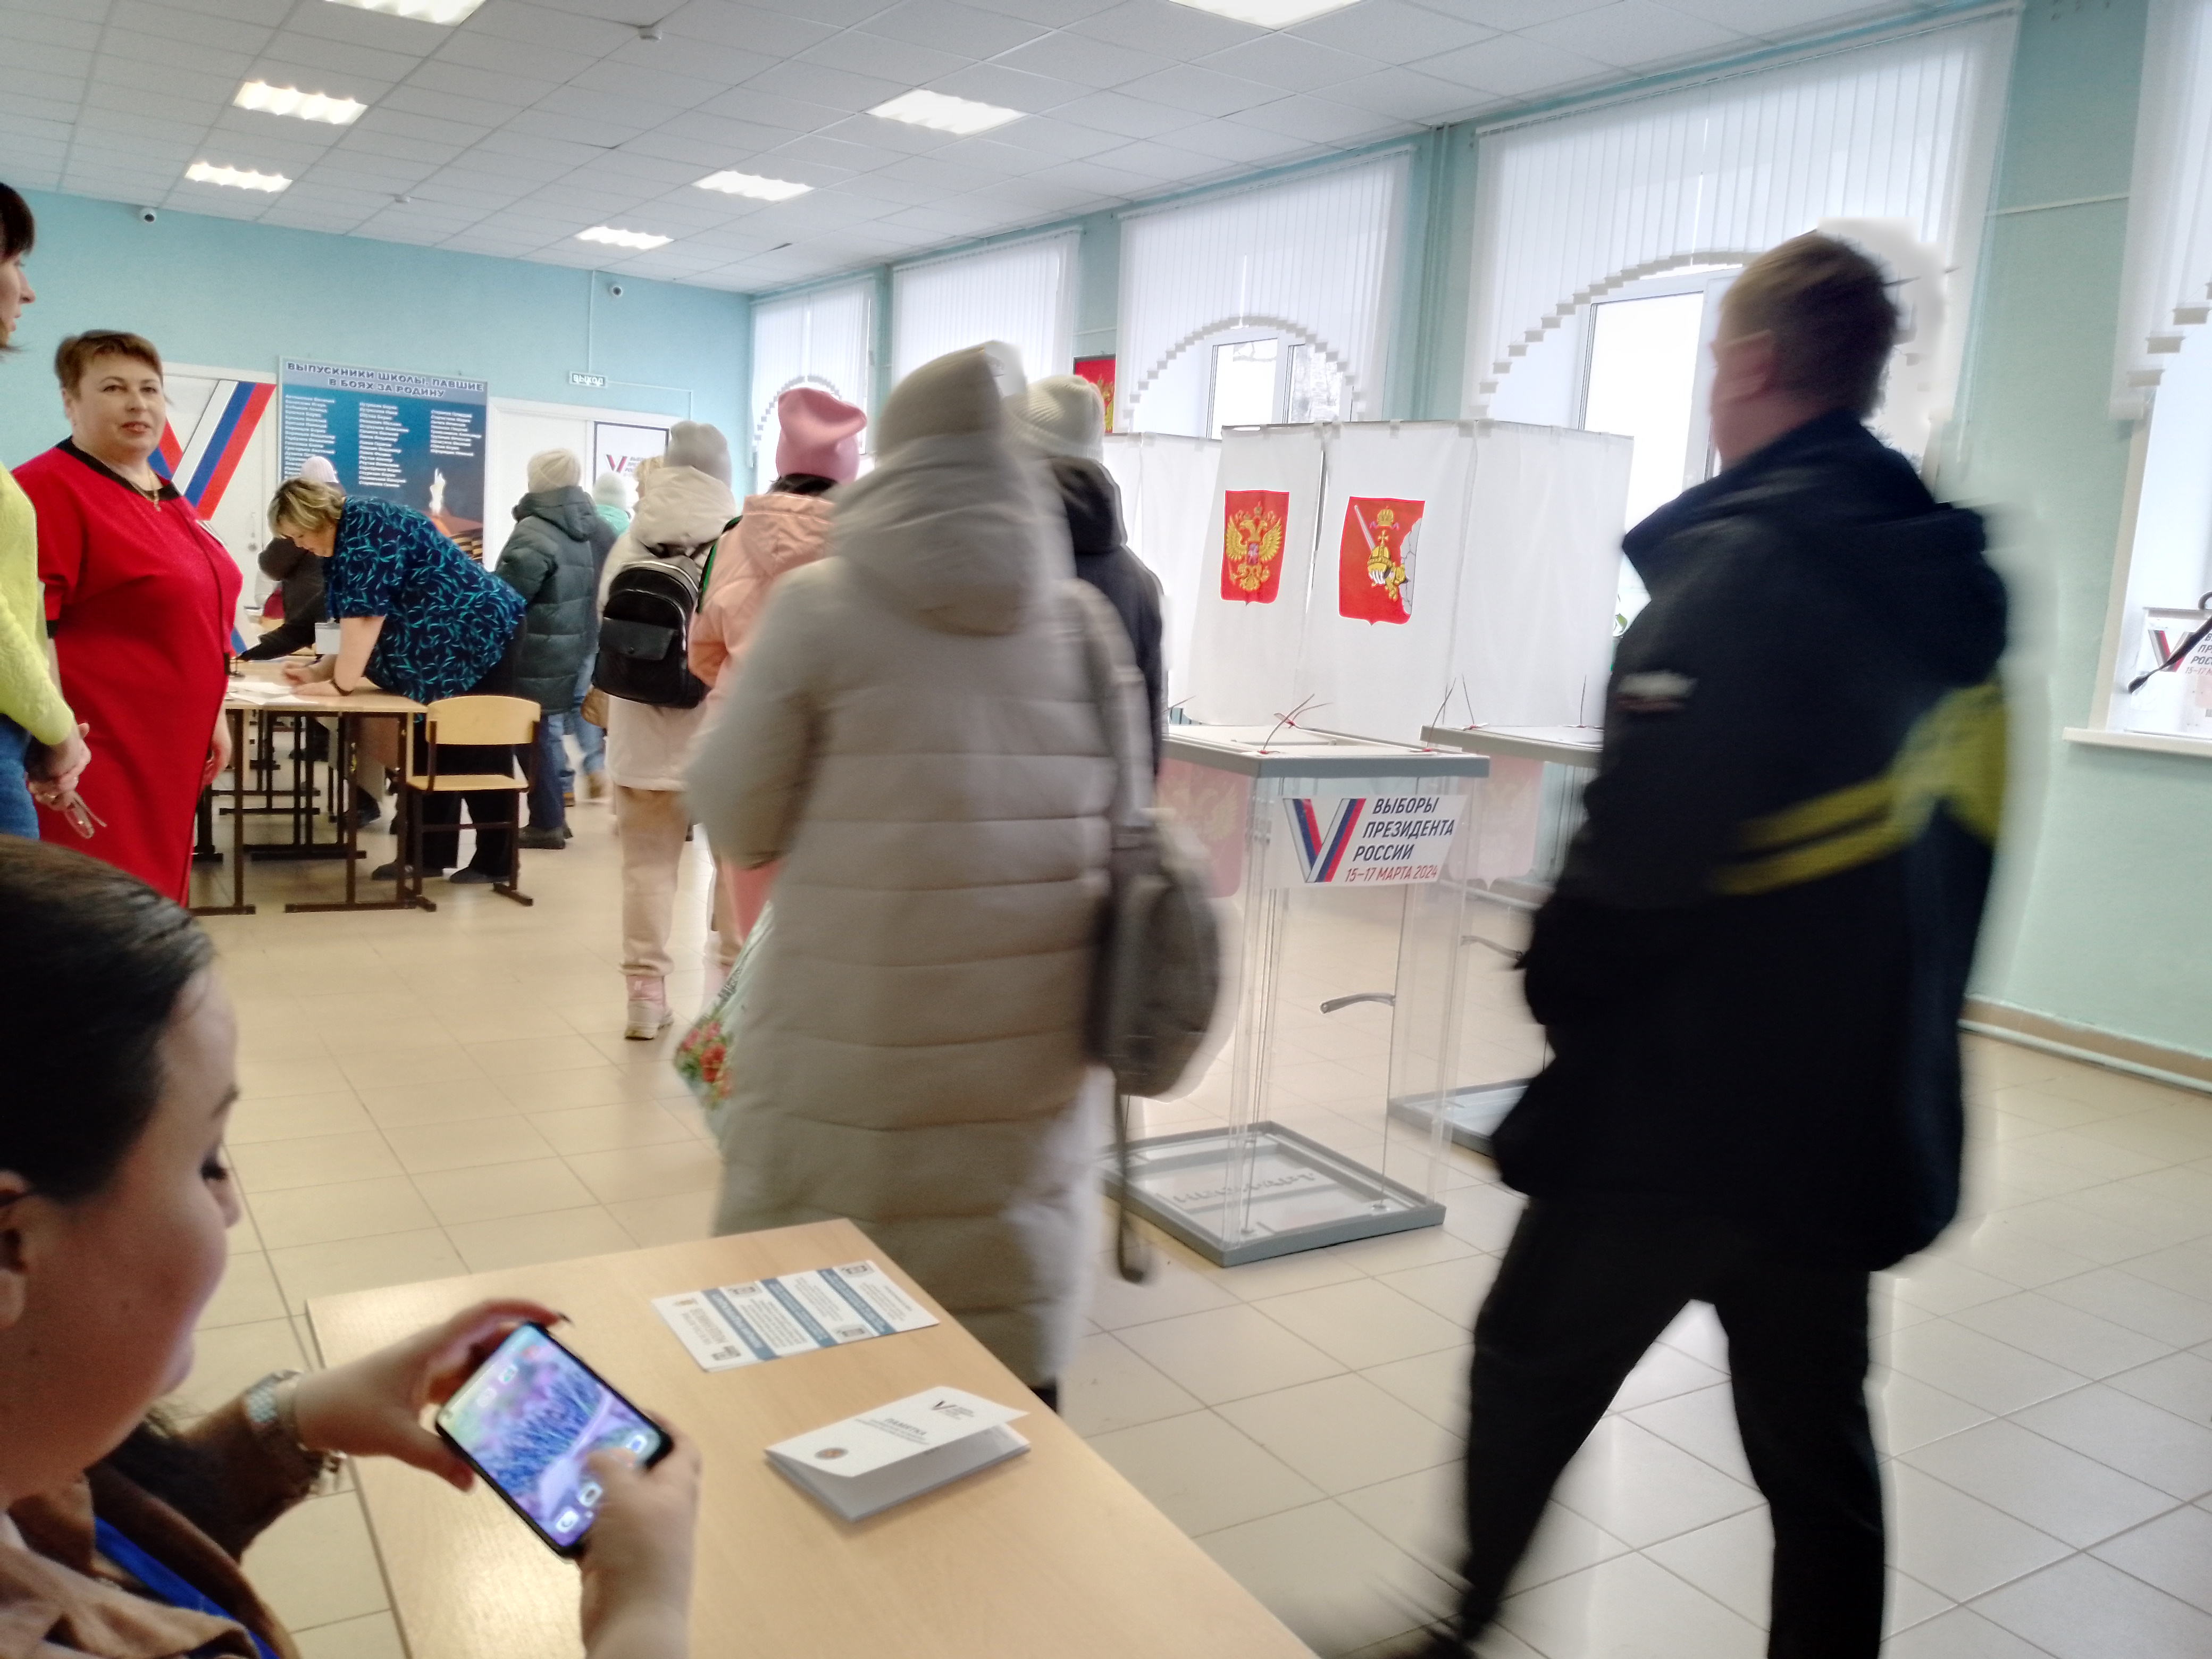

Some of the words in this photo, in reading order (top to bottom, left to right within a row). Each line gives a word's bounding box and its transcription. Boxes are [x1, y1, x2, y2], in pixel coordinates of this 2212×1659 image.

[287, 362, 374, 379] ВЫПУСКНИКИ
[432, 379, 483, 391] ПАВШИЕ
[573, 374, 604, 386] ВЫХОД
[340, 380, 374, 390] БОЯХ
[396, 386, 445, 397] РОДИНУ
[2197, 644, 2212, 653] ПР
[2190, 656, 2212, 665] РОС
[1372, 798, 1439, 815] ВЫБОРЫ
[1362, 819, 1455, 839] ПРЕЗИДЕНТА
[1353, 844, 1414, 862] РОССИИ
[1376, 866, 1412, 881] МАРТА
[1413, 865, 1437, 879] 2024
